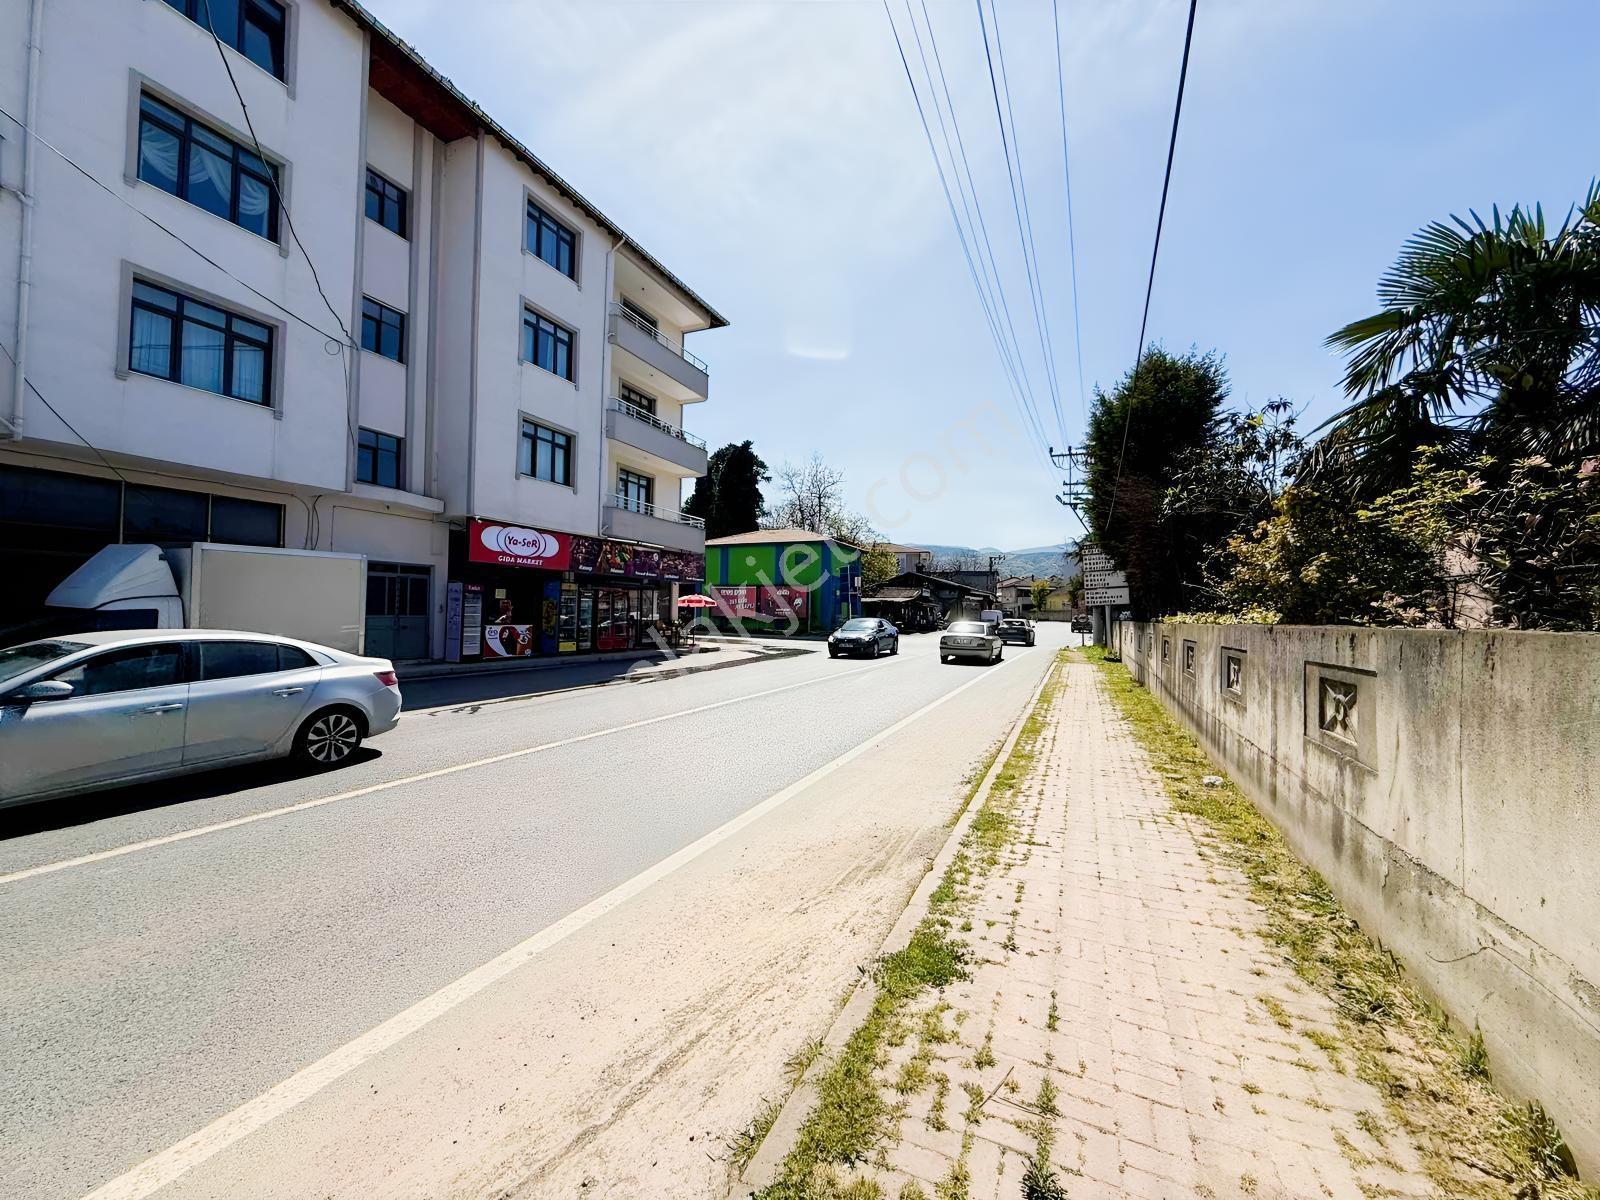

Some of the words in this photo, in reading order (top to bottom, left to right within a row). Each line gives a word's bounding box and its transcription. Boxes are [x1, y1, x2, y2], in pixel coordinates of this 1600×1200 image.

[507, 535, 538, 549] Ya-SeR
[498, 555, 515, 563] GIDA
[516, 557, 543, 566] MARKET
